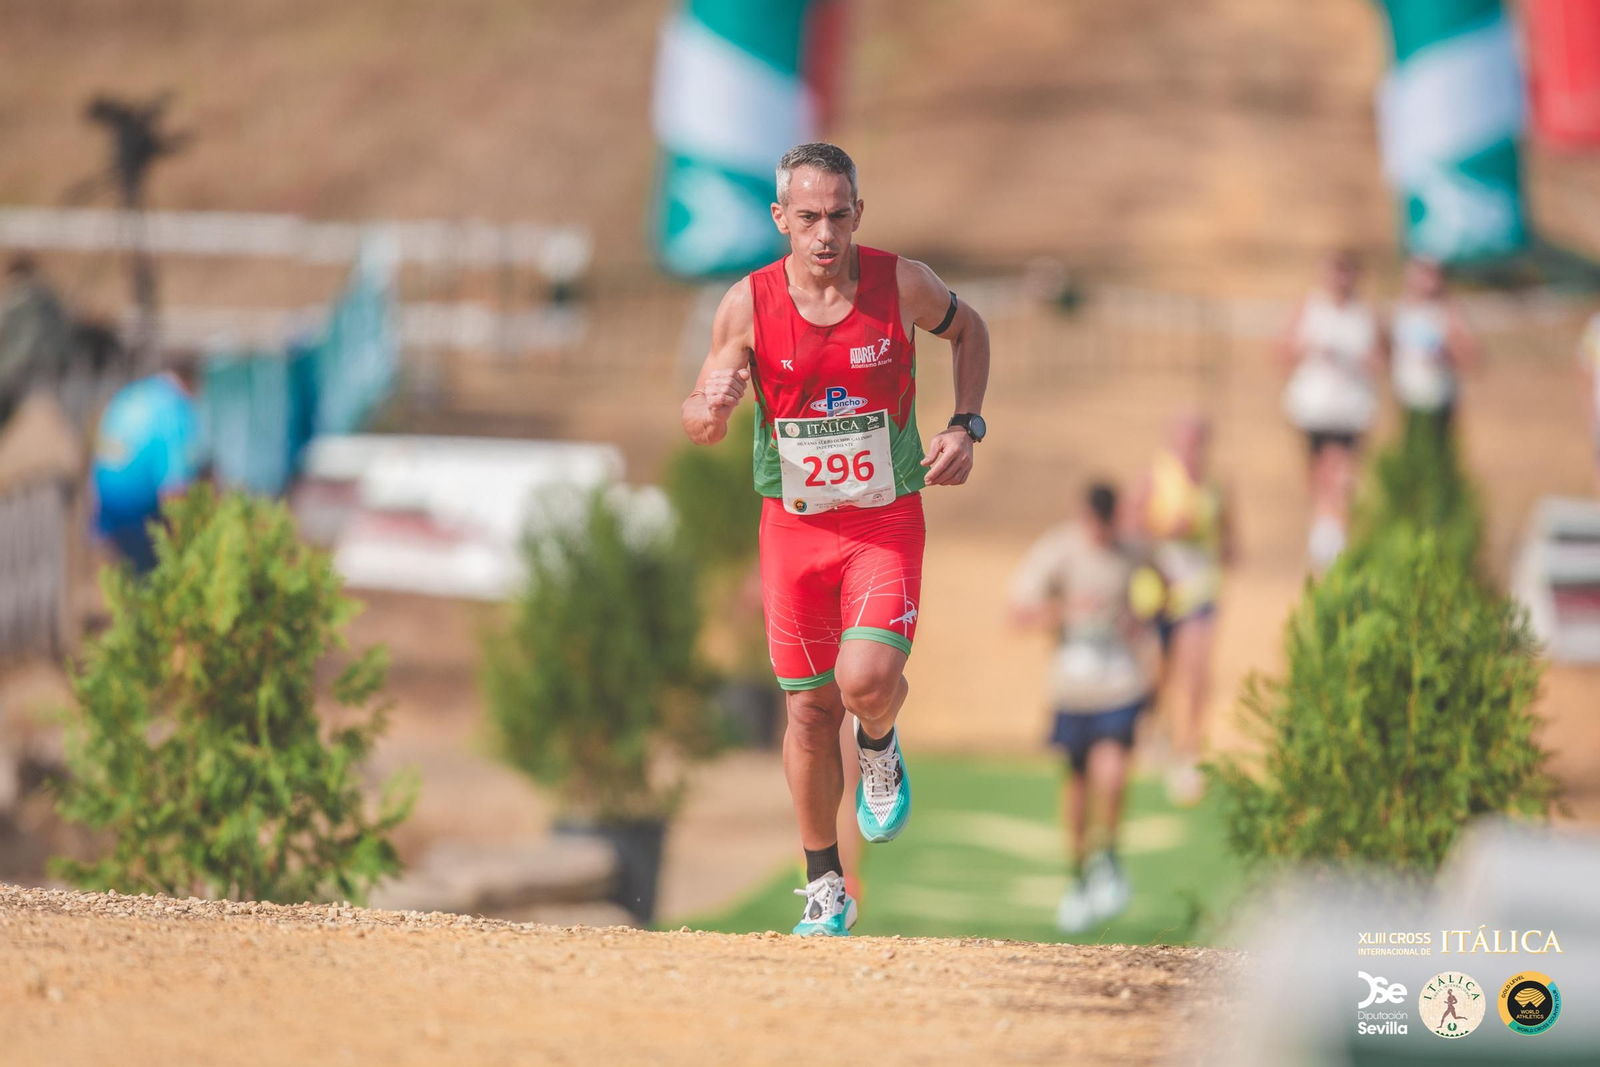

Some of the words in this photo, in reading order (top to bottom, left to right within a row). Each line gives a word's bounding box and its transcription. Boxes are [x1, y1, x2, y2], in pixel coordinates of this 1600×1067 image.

[850, 345, 876, 364] ATARFE
[806, 419, 860, 435] ITÁLICA
[802, 450, 875, 487] 296
